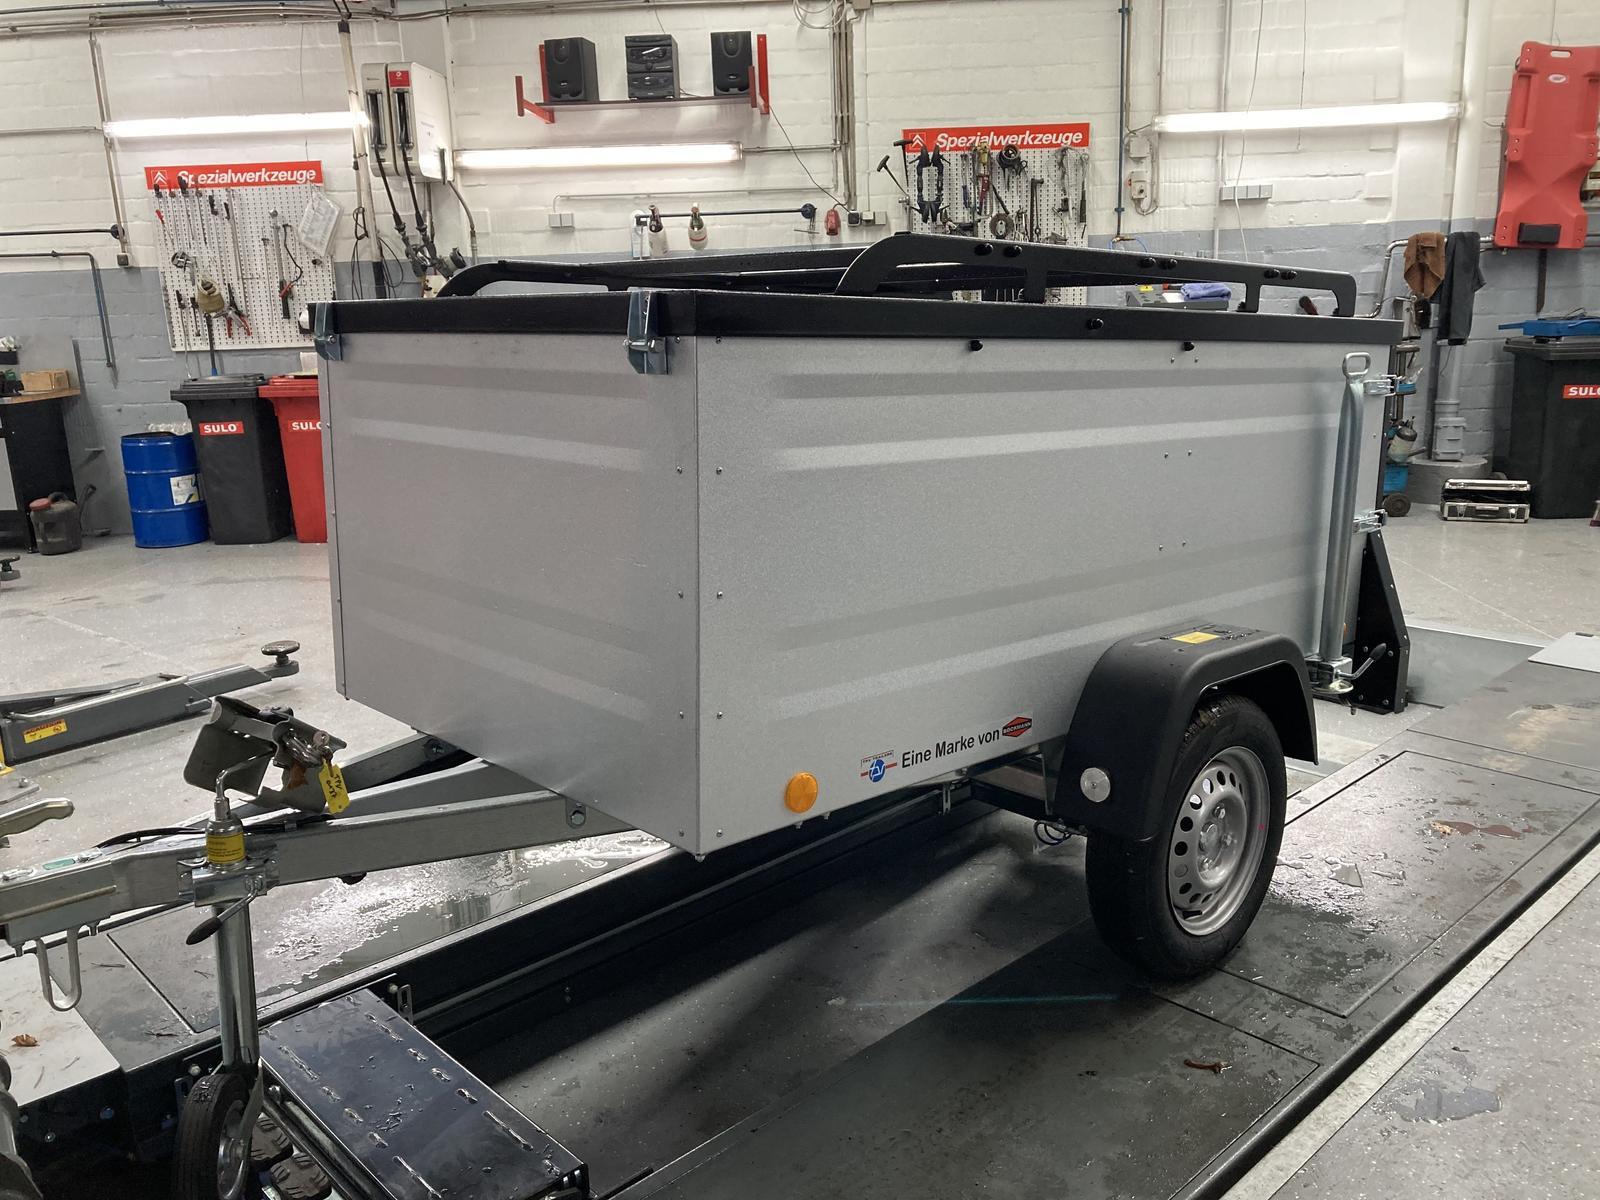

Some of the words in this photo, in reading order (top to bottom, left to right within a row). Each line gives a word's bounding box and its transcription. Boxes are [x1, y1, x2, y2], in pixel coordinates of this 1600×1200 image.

[936, 131, 1083, 150] Spezialwerkzeuge
[203, 423, 238, 433] SULO
[902, 750, 932, 768] Eine
[935, 736, 975, 758] Marke
[978, 729, 1000, 745] von
